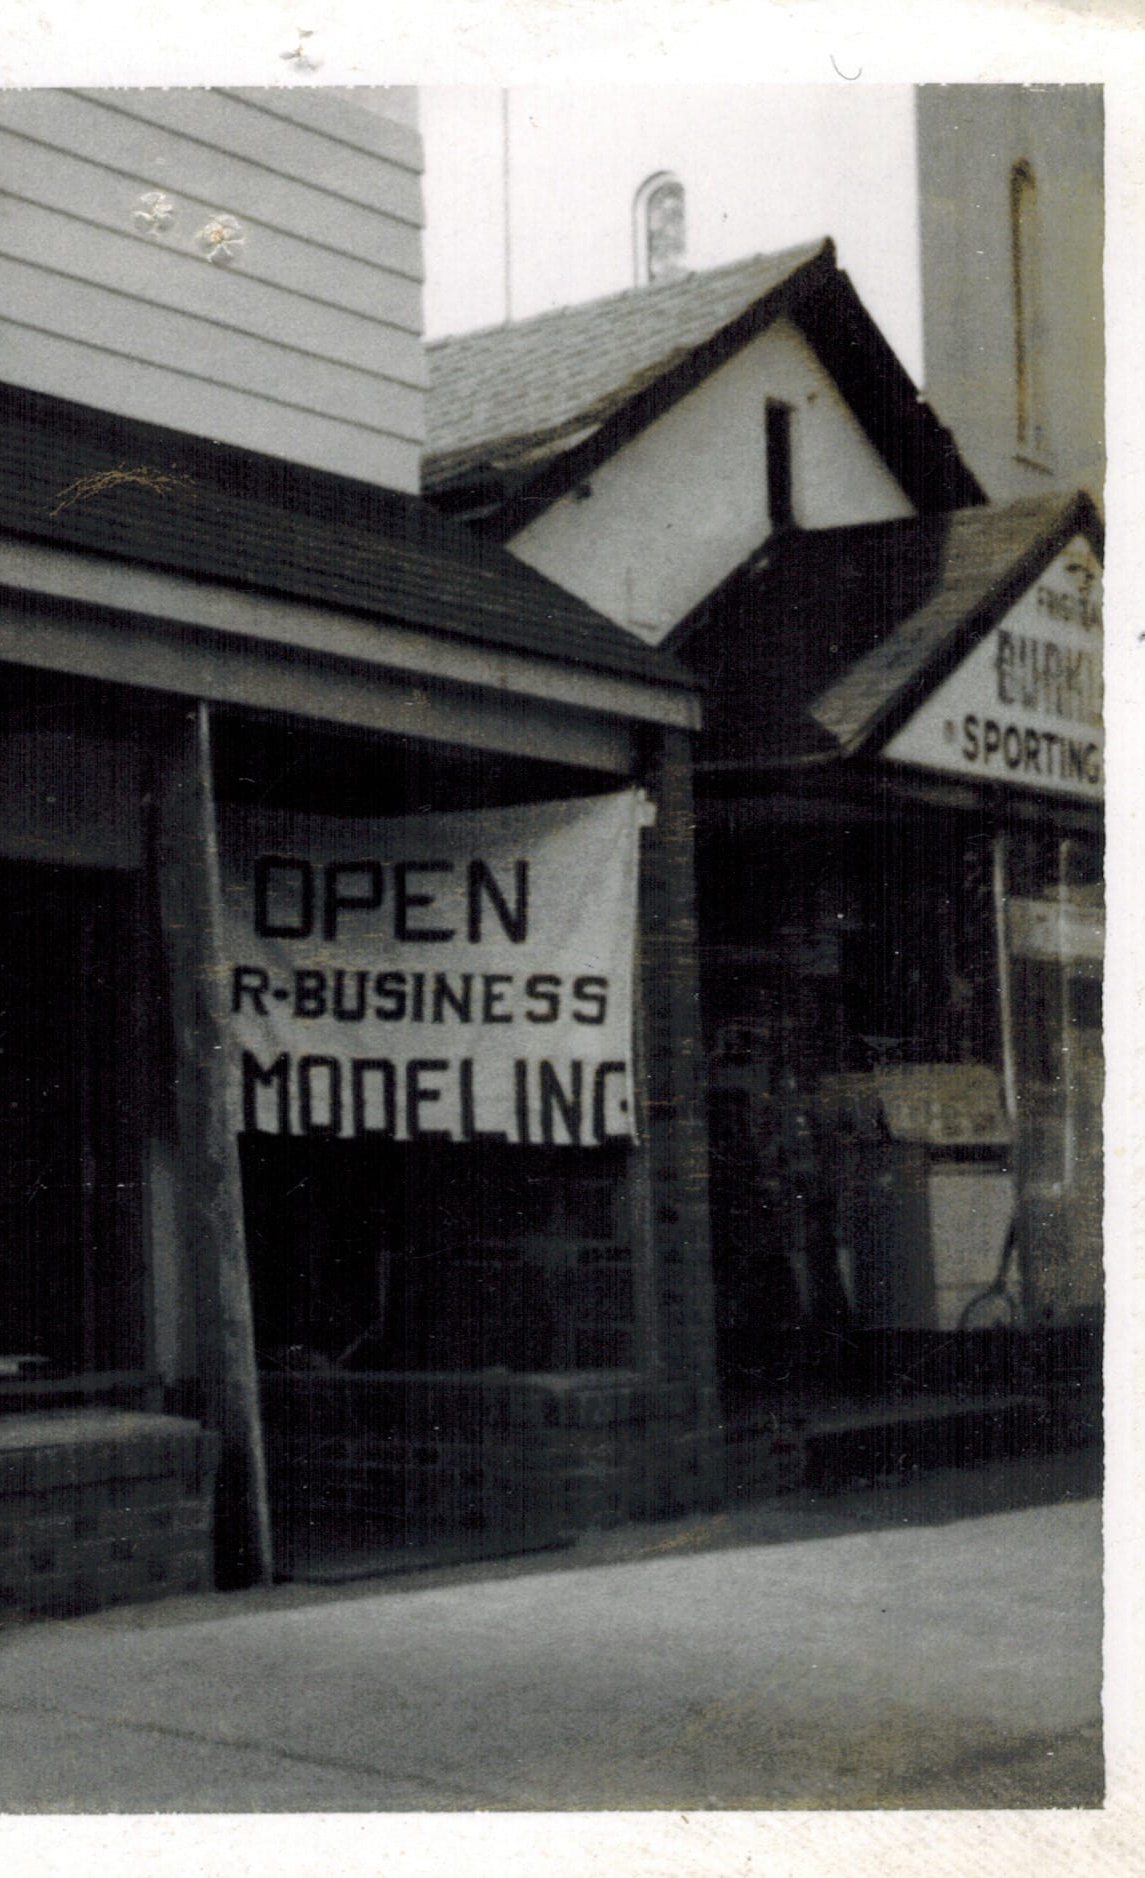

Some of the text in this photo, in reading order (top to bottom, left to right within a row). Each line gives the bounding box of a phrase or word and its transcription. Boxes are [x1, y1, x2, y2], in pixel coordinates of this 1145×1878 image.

[962, 713, 1100, 785] SPORTING
[256, 854, 530, 944] OPEN
[241, 1049, 631, 1146] MODELING
